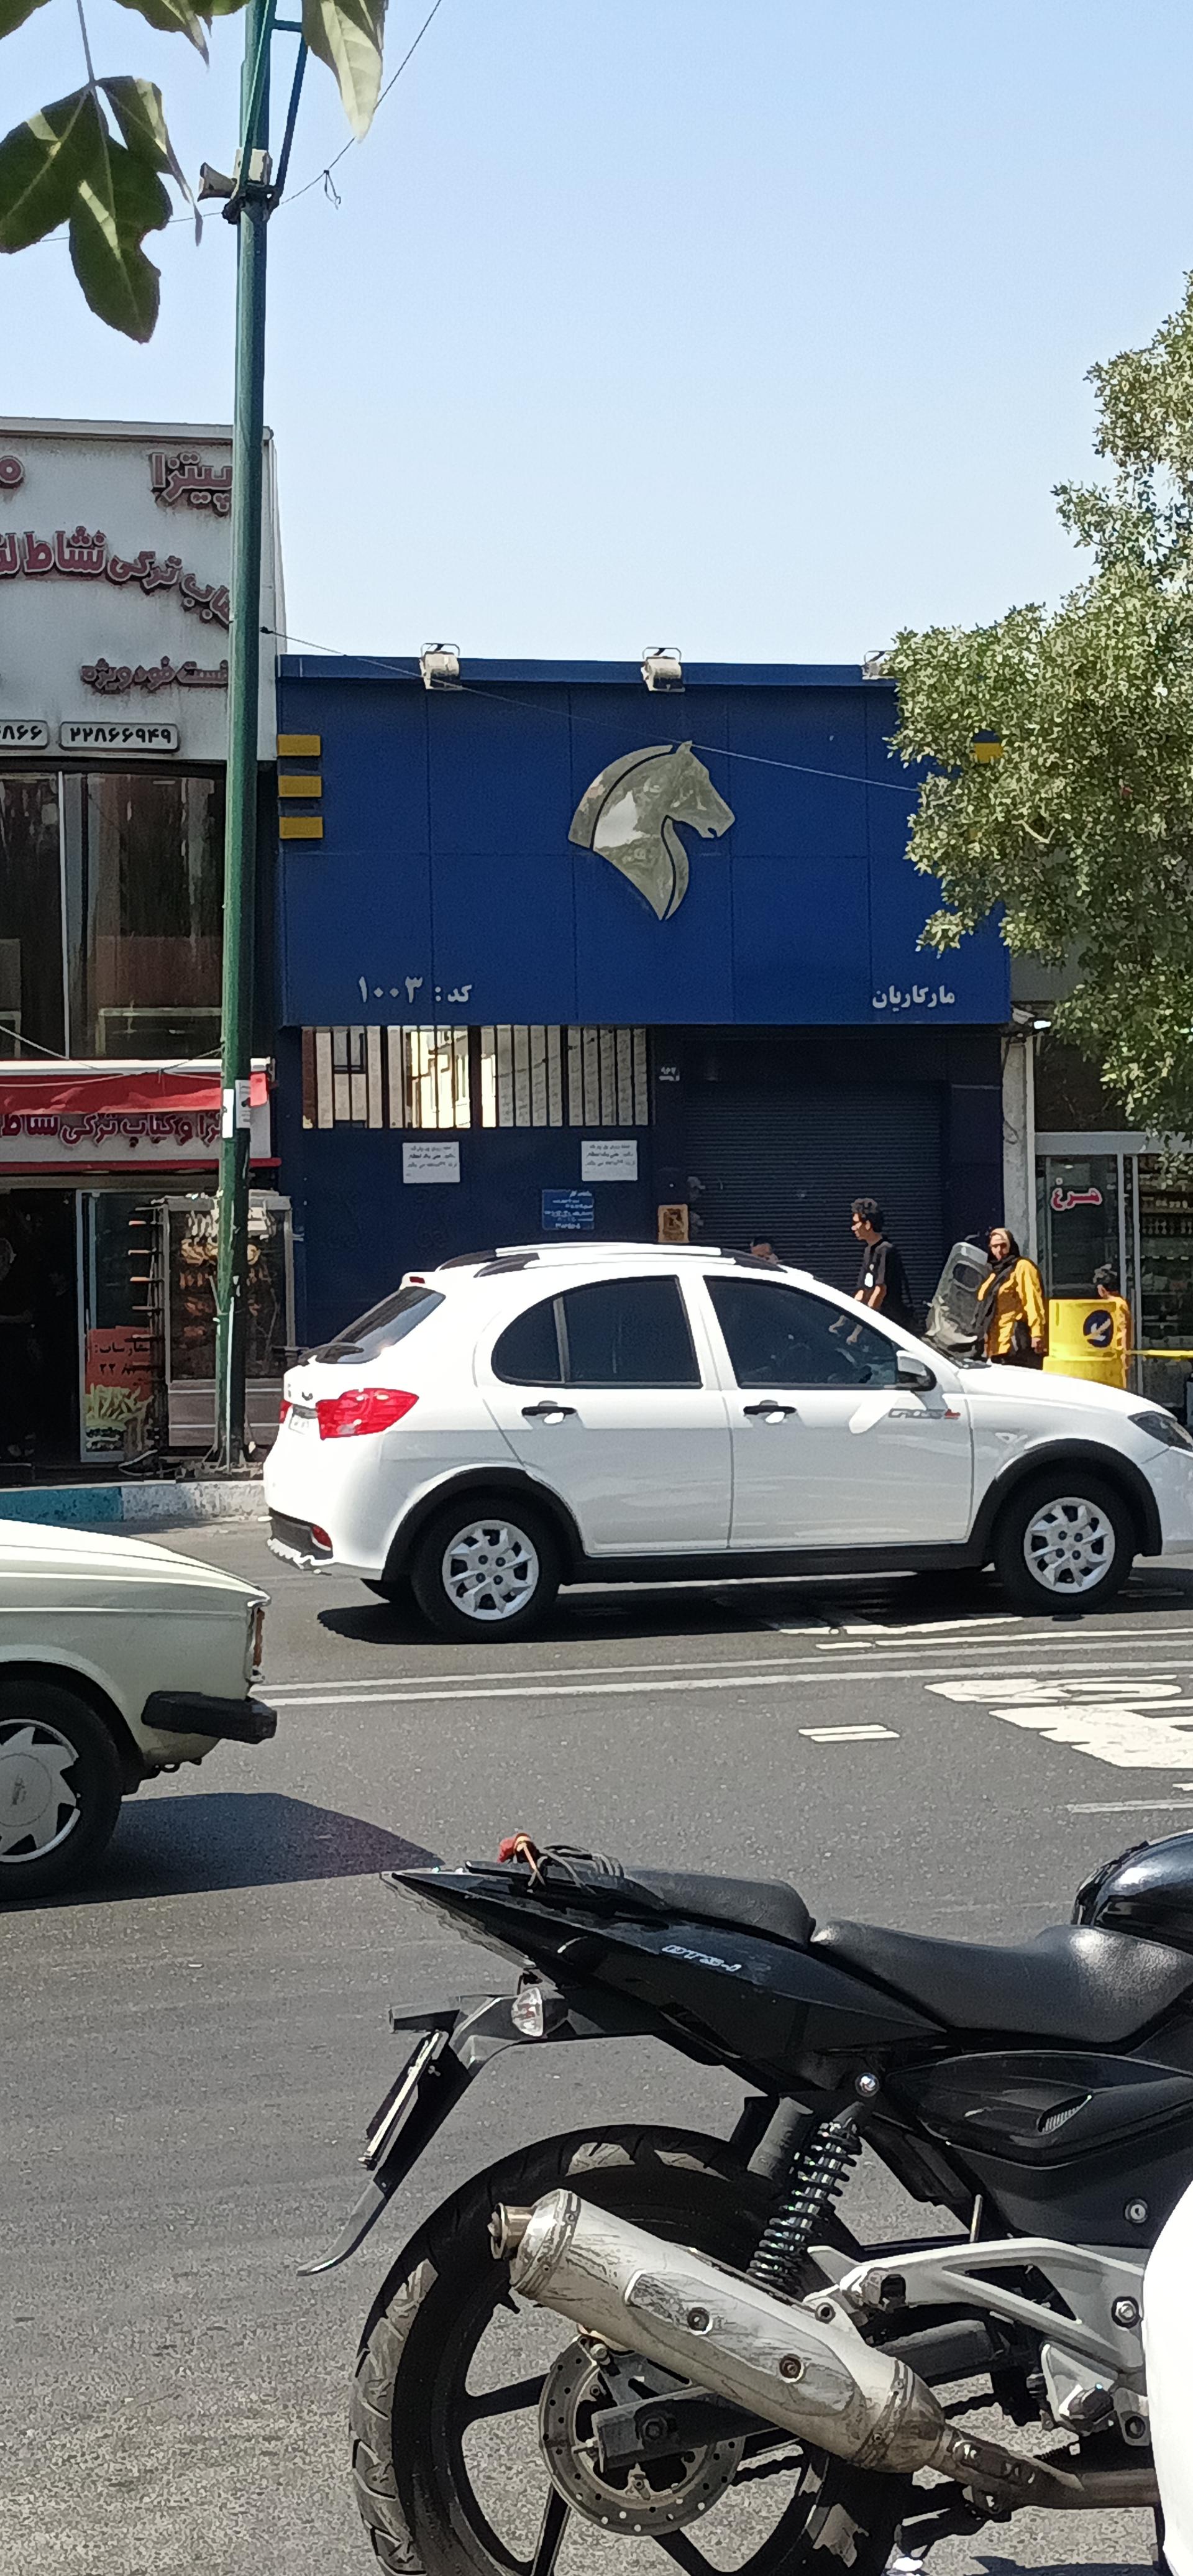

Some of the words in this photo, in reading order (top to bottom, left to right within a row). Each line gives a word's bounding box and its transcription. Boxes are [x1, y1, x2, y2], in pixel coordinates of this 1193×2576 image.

[23, 526, 106, 574] نشاط
[107, 551, 181, 590] ترکی
[70, 727, 171, 744] ۲۲۸۶۶۹۴۹
[359, 976, 423, 1004] ۱۰۰۳
[872, 985, 956, 1012] مارکاریان
[1051, 1177, 1103, 1211] مرغ
